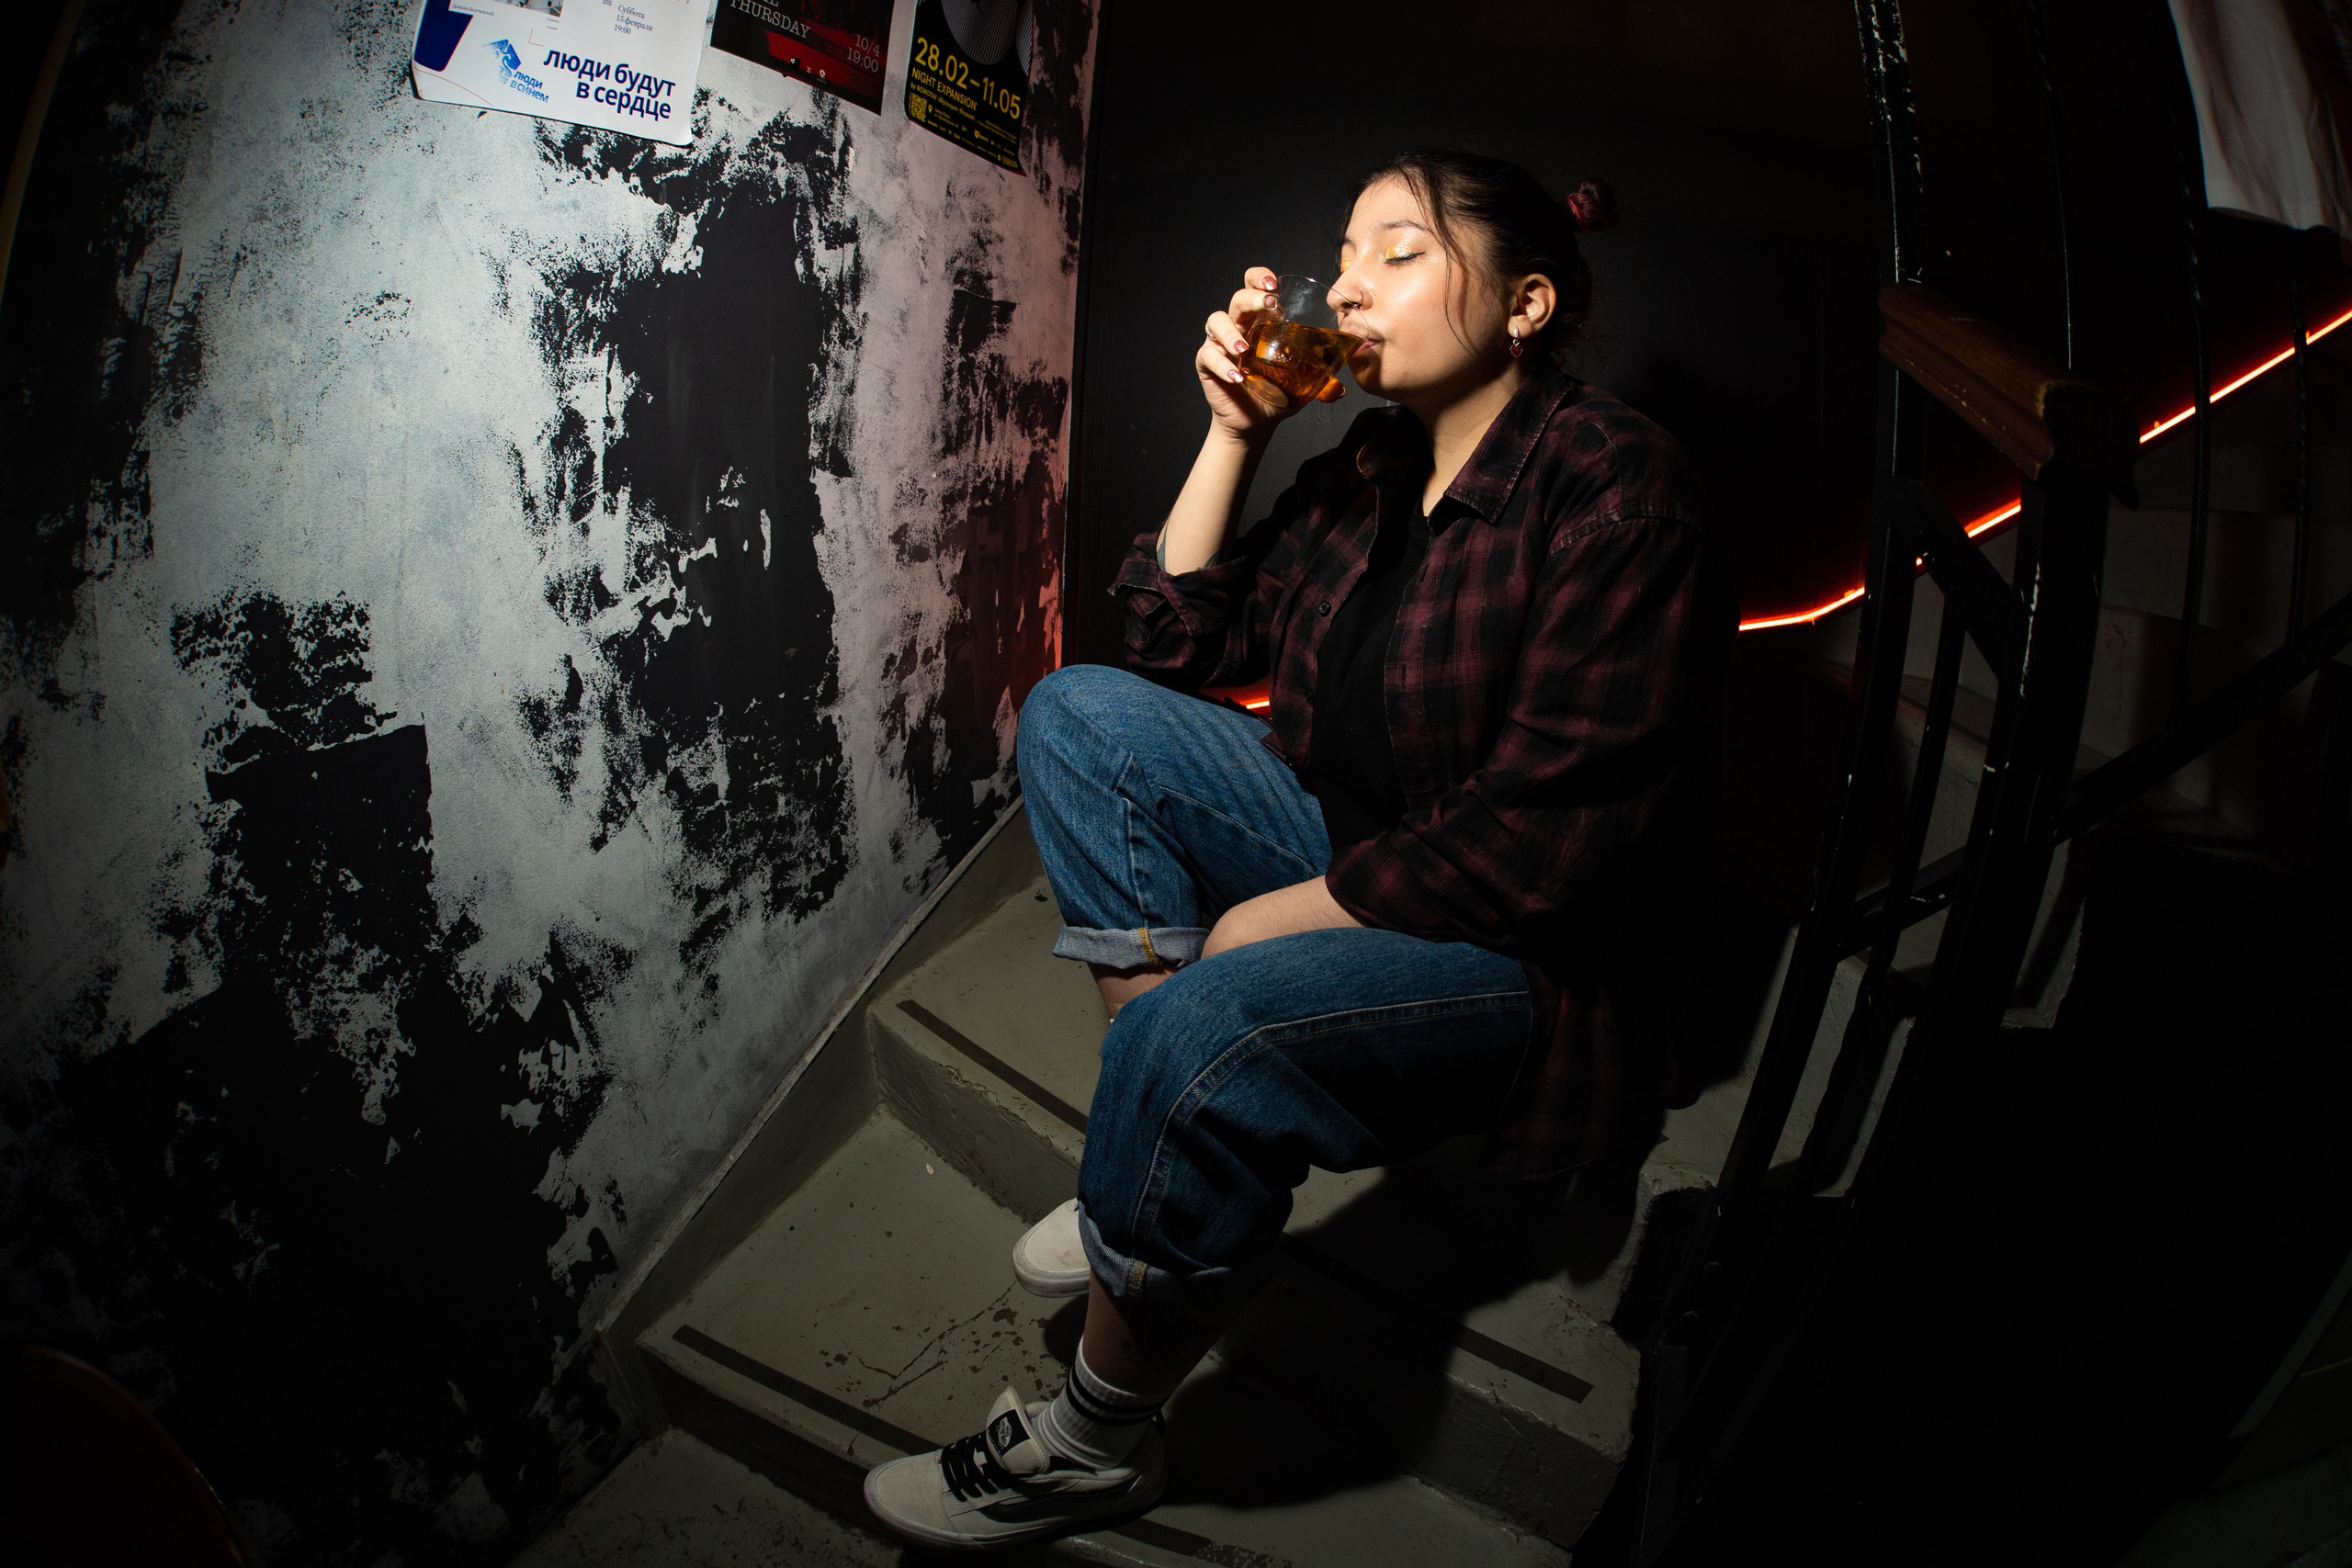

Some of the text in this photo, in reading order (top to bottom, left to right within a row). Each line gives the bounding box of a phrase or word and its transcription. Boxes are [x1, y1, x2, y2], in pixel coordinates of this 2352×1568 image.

[616, 14, 653, 31] 15 февраля
[617, 5, 645, 19] Суббота
[730, 0, 811, 39] THURSDAY
[614, 24, 632, 35] 19:00
[856, 33, 880, 57] 10/4
[846, 51, 879, 73] 19:00
[615, 62, 676, 99] будут
[912, 67, 936, 89] NIGHT
[576, 81, 672, 121] в сердце
